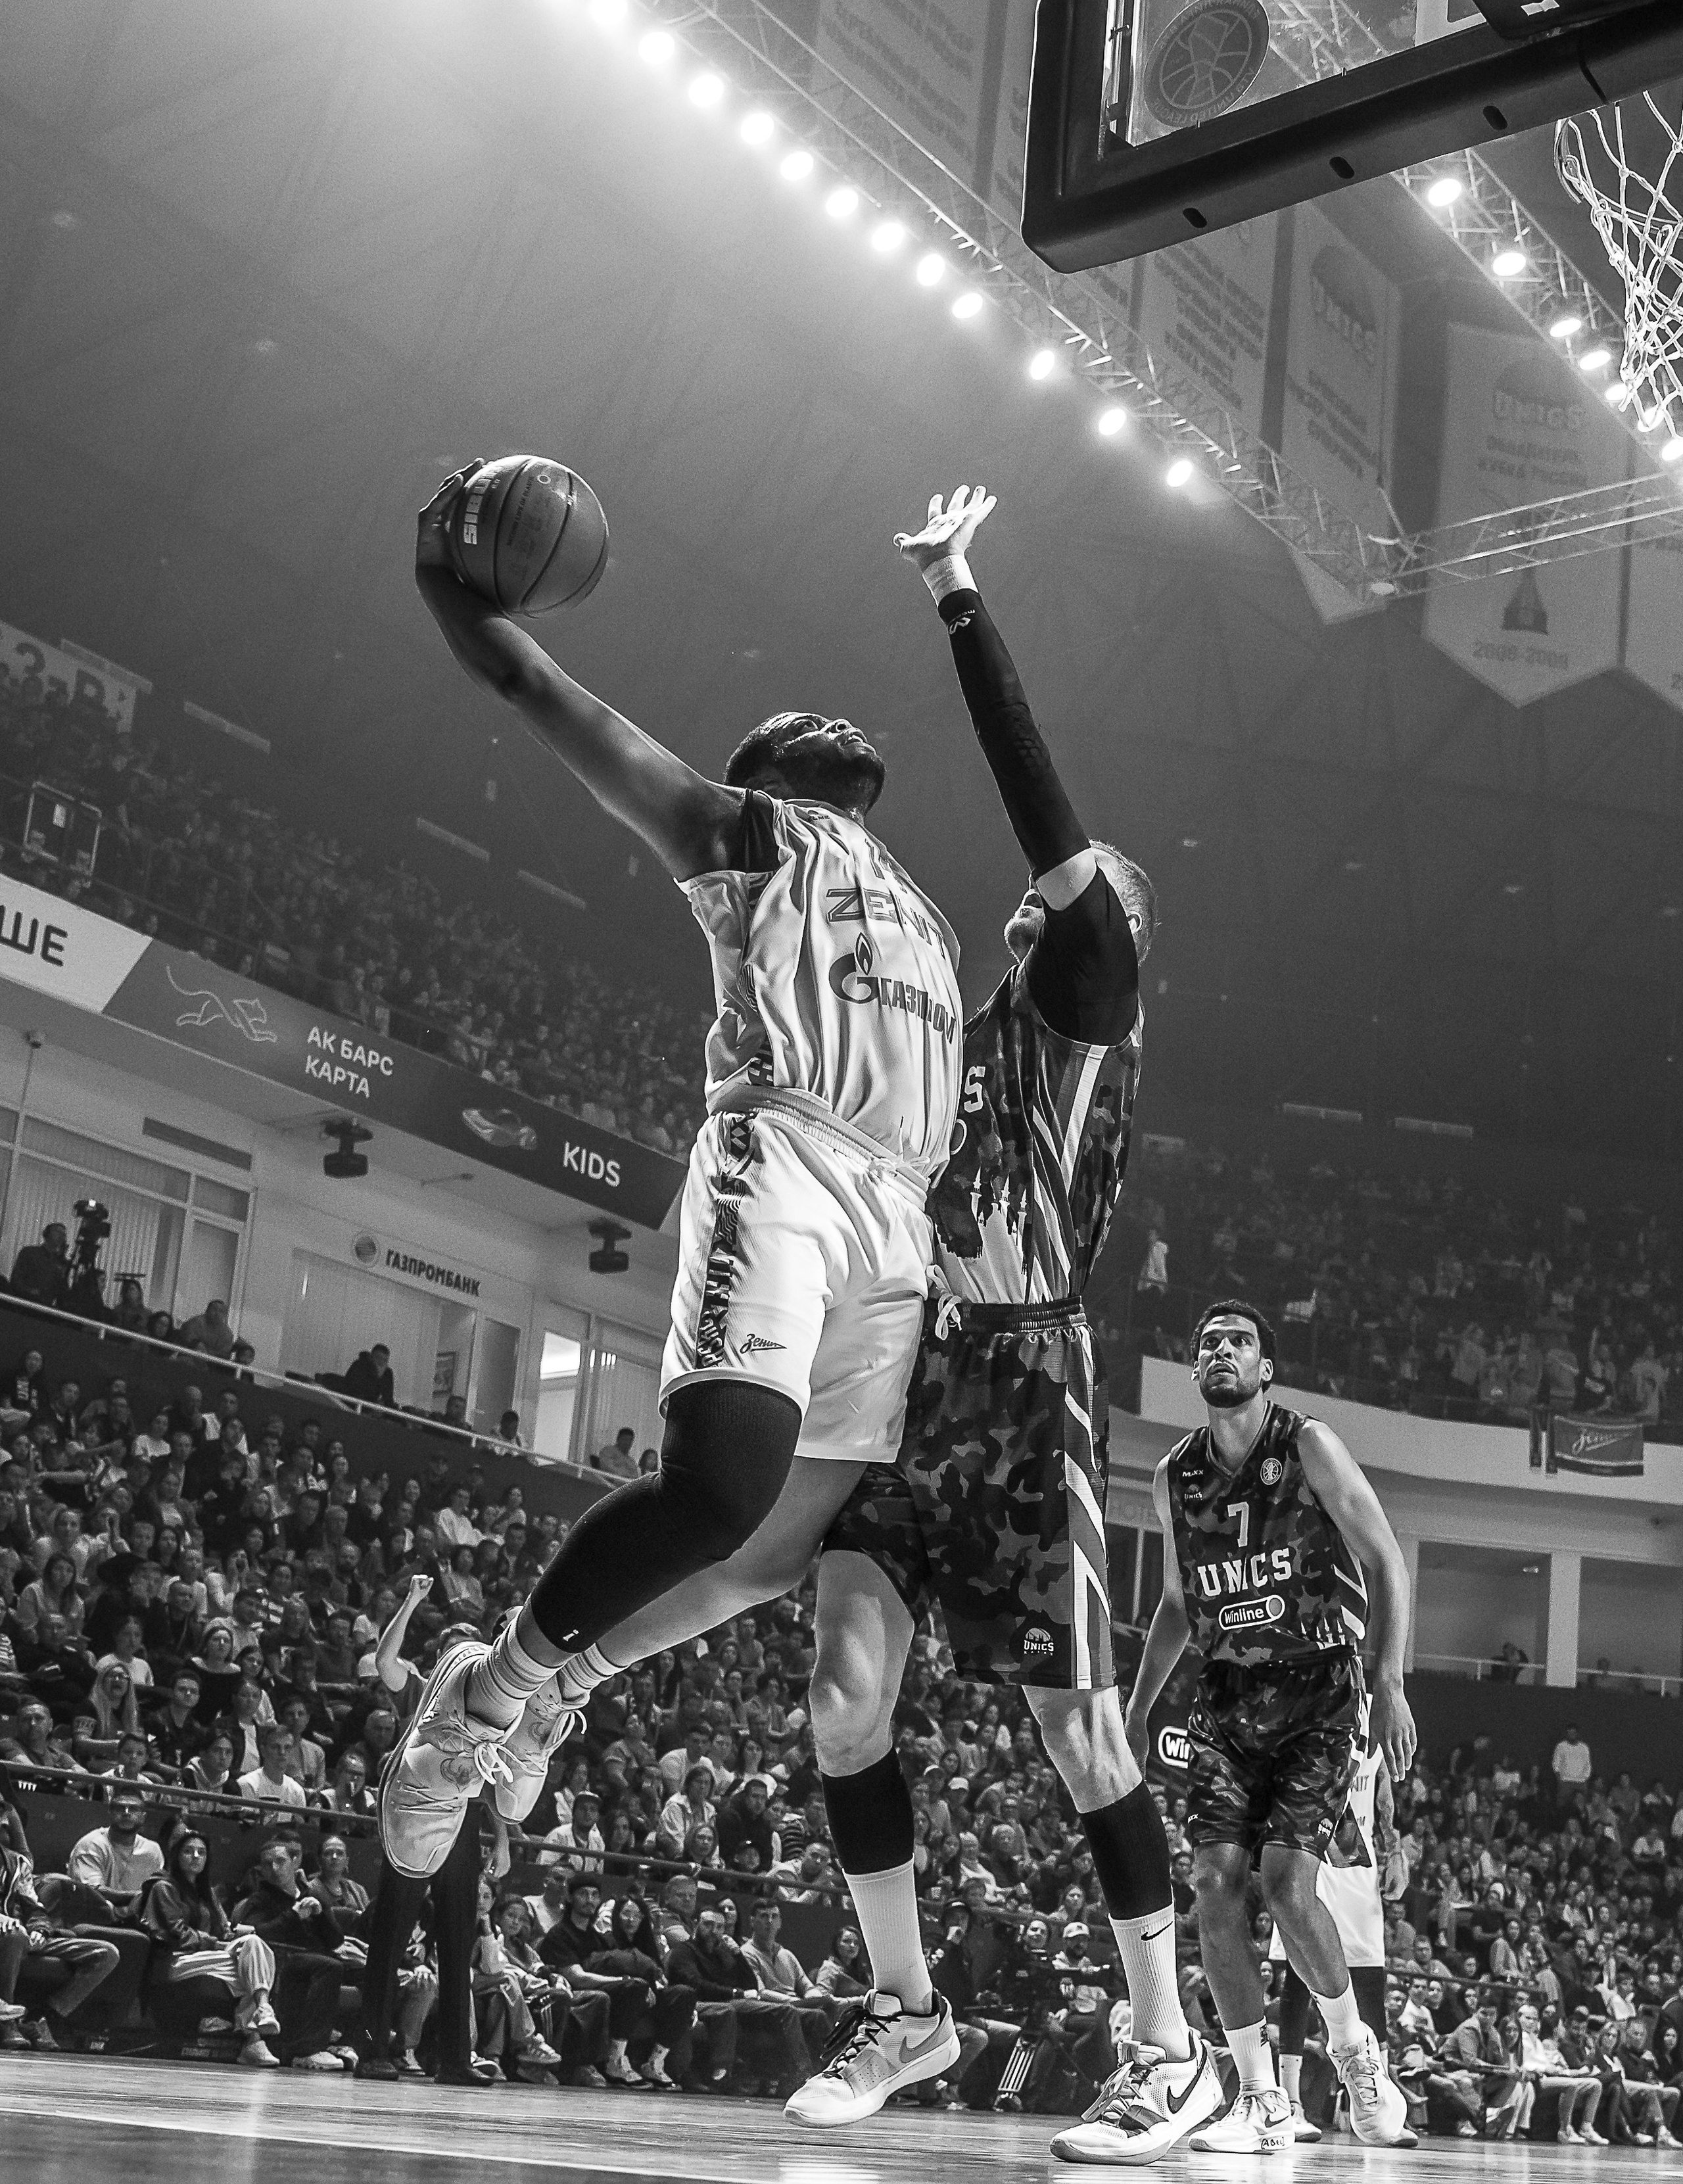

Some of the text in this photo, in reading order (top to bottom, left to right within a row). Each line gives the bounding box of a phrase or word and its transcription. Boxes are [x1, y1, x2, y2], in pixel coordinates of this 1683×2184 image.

[826, 887, 945, 961] ZENIT
[307, 1026, 394, 1076] АК БАРС
[305, 1055, 370, 1099] КАРТА
[563, 1141, 621, 1187] KIDS
[386, 1249, 481, 1297] ГАЗПРОМБАНК
[1227, 1502, 1249, 1548] 7
[1197, 1548, 1292, 1597] UNCS
[1224, 1606, 1265, 1625] Winline
[1024, 1640, 1055, 1651] UNICS
